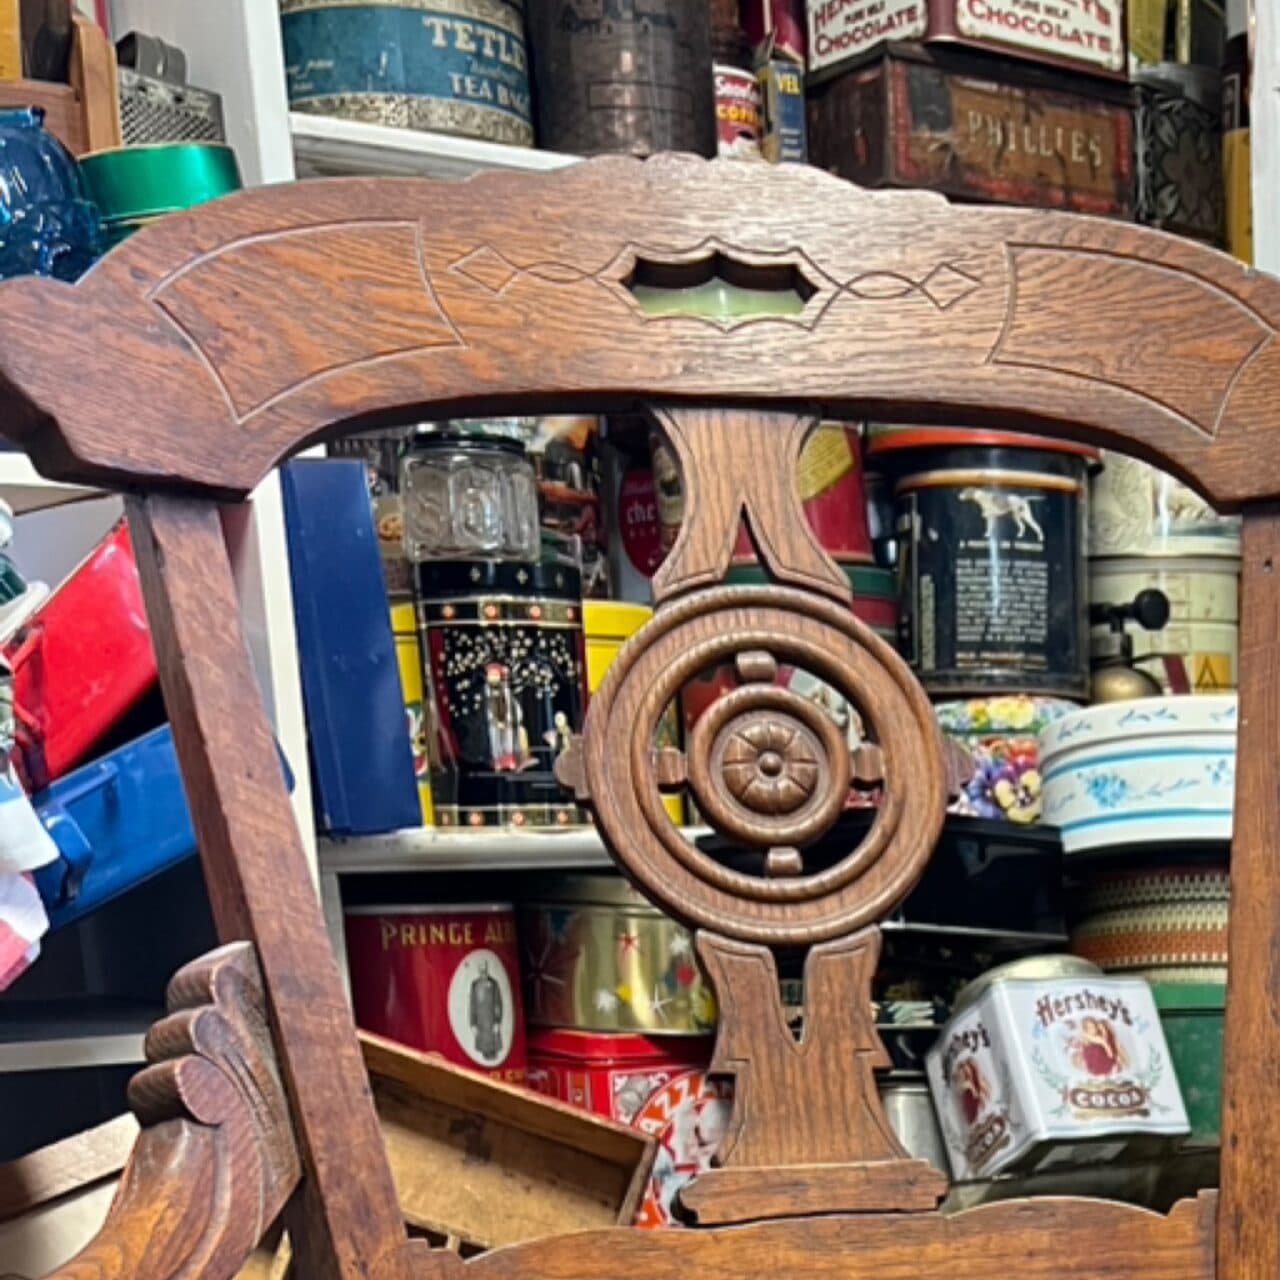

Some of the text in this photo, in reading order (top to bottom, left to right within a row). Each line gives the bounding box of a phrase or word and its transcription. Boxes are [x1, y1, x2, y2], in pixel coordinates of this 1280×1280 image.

[815, 4, 918, 56] CHOCOLATE
[967, 0, 1111, 53] CHOCOLATE
[448, 71, 493, 100] TEA
[968, 110, 1102, 168] PHILLIES
[380, 917, 474, 950] PRINCE
[1036, 988, 1133, 1027] Hershey's
